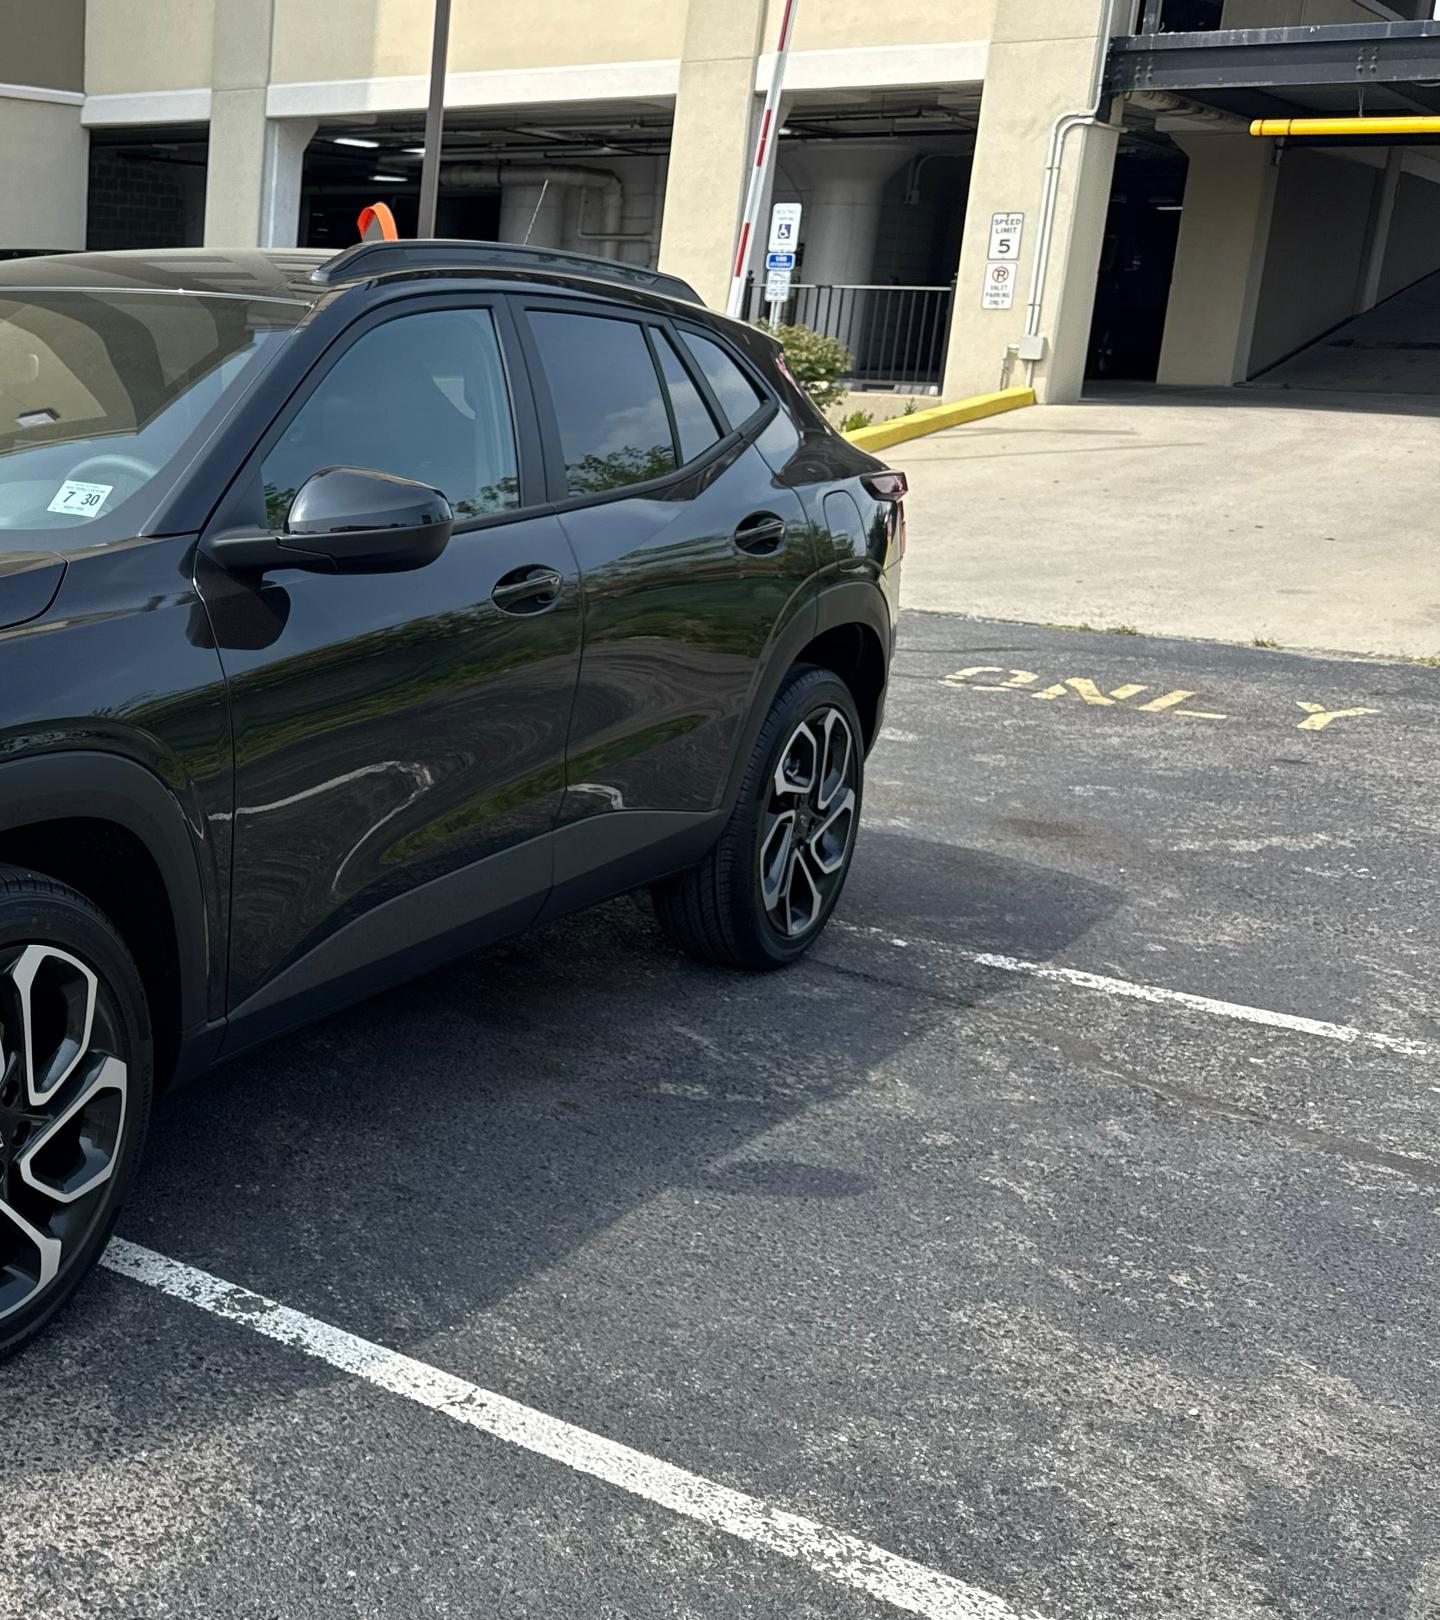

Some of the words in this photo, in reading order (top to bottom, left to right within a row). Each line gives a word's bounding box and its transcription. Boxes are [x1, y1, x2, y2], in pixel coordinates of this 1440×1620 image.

[998, 239, 1010, 254] 5
[63, 491, 76, 503] 7
[80, 493, 101, 506] 30
[939, 666, 1380, 731] ONLY
